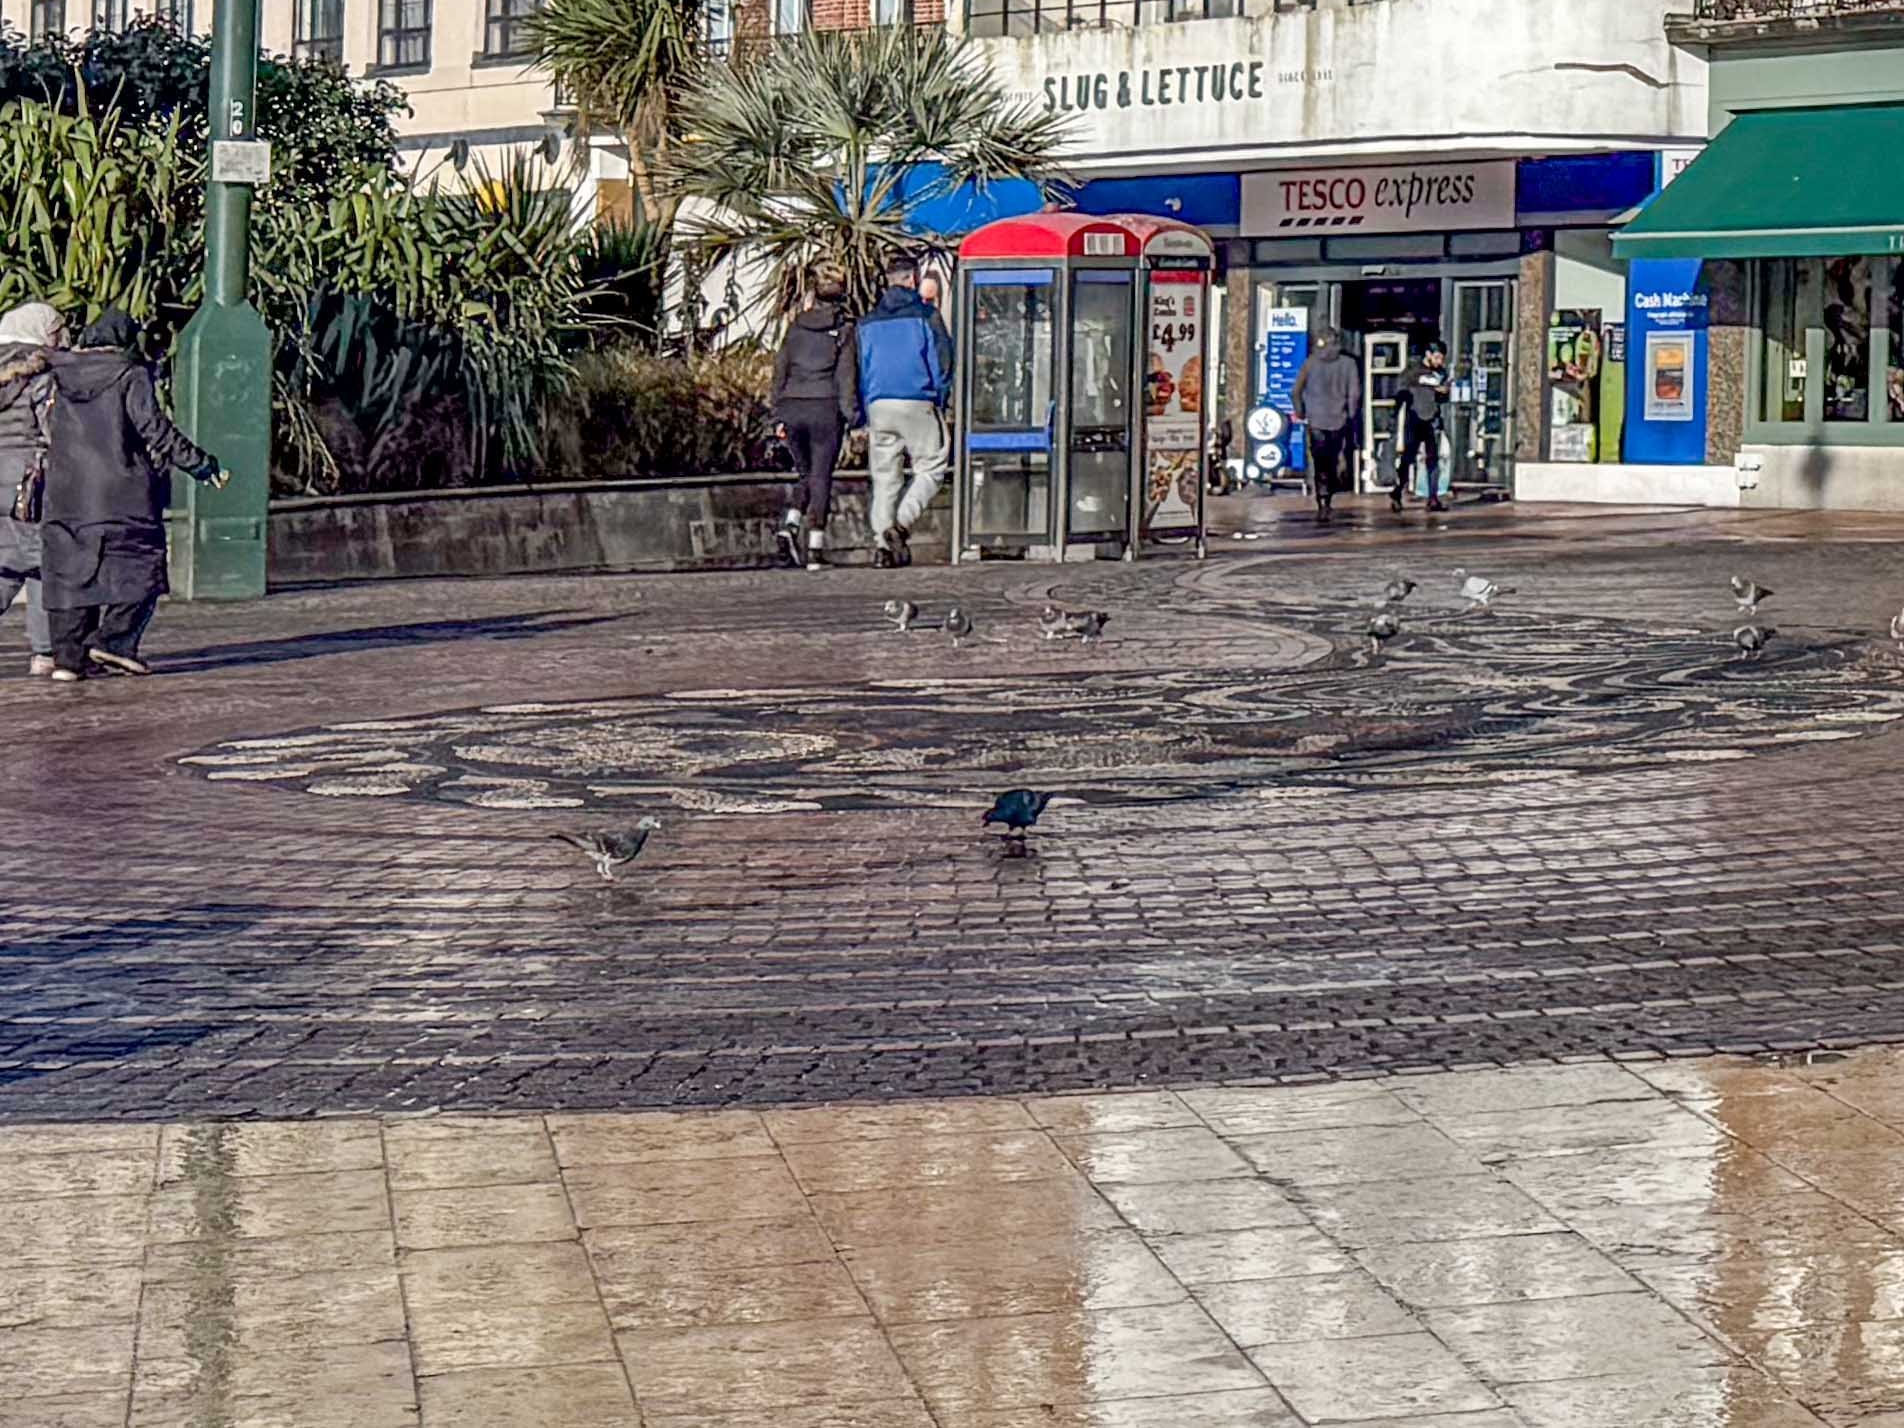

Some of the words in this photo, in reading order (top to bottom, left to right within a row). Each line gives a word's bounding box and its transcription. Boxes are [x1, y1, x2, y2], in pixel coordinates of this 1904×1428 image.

[1043, 73, 1108, 111] SLUG
[1117, 71, 1131, 108] &
[1141, 61, 1264, 106] LETTUCE
[1279, 177, 1366, 212] TESCO
[1374, 172, 1475, 218] express
[1634, 292, 1661, 309] Cash
[1662, 291, 1708, 307] Machine
